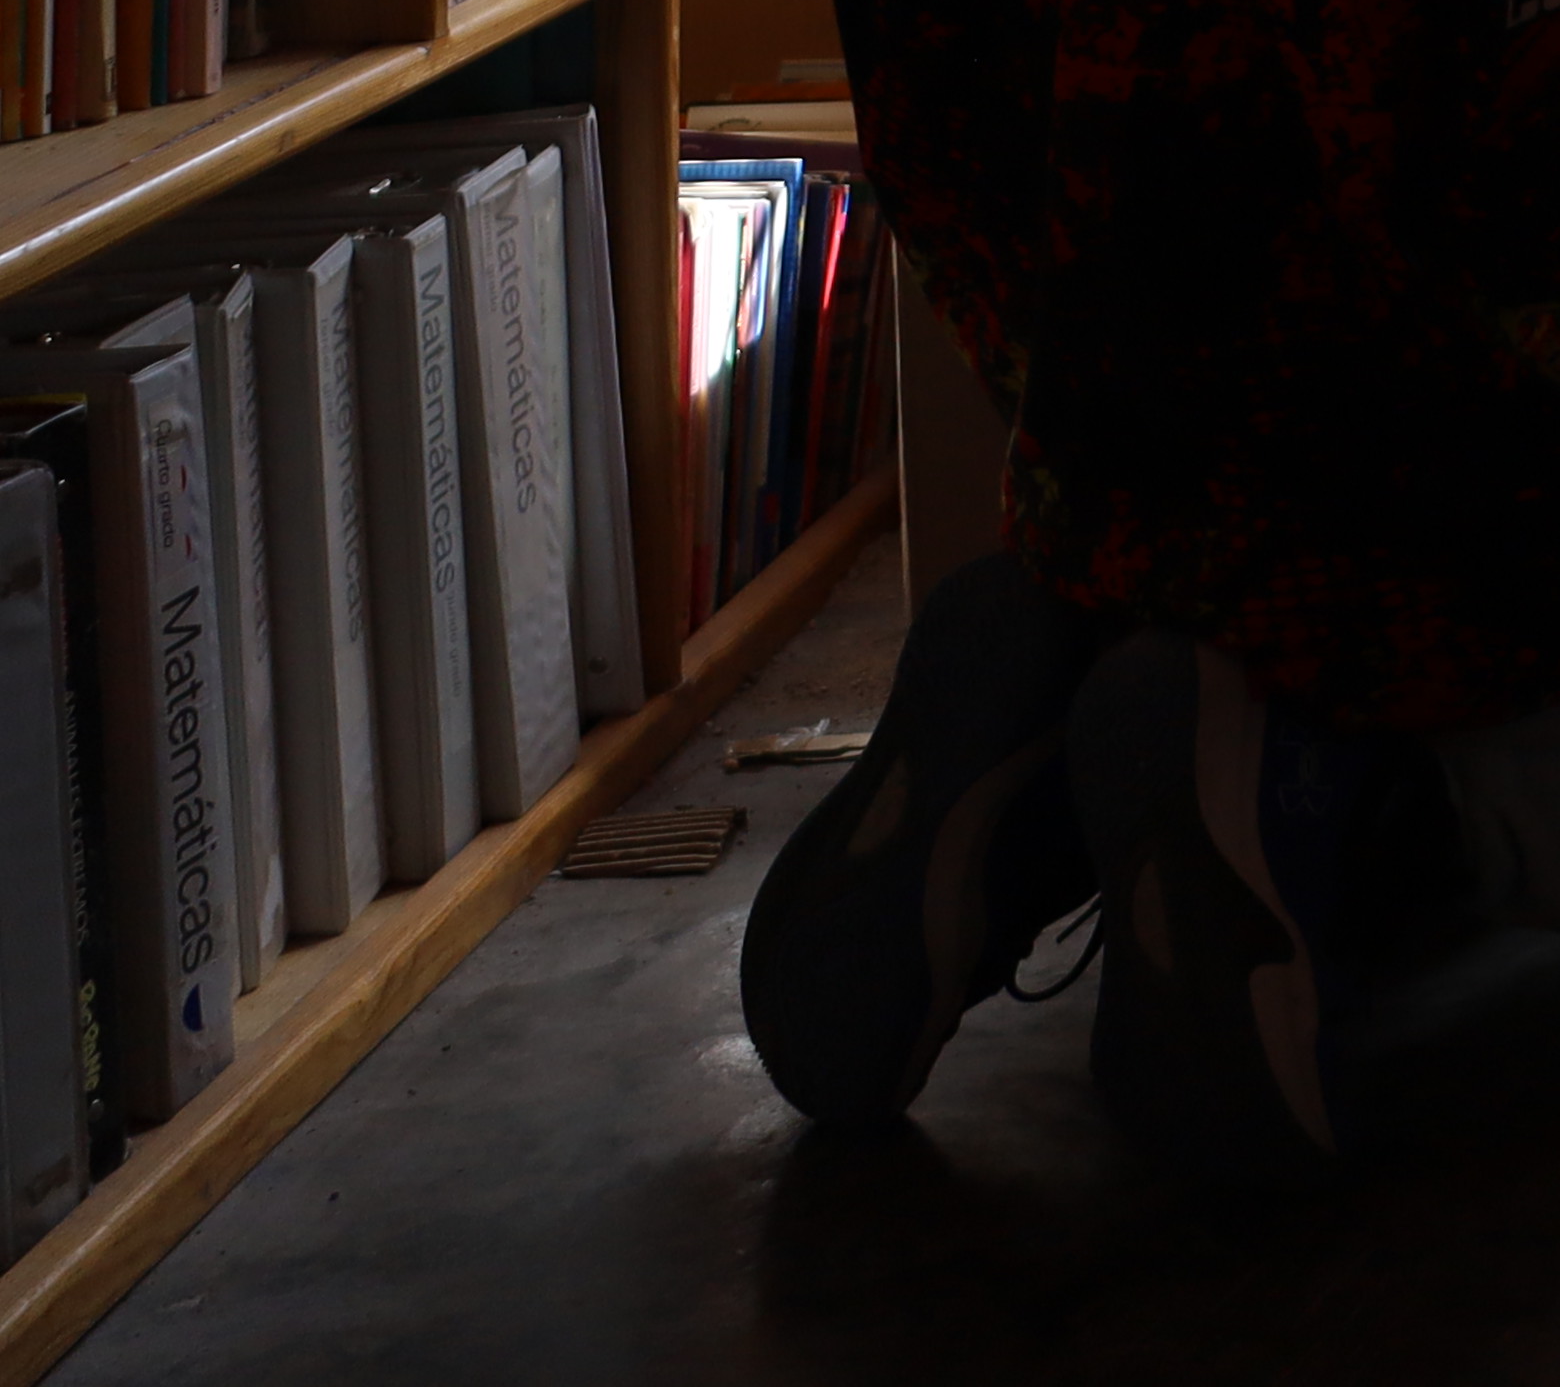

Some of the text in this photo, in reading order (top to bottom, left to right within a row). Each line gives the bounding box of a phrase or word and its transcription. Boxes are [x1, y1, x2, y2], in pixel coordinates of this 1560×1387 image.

[154, 419, 174, 547] Cuarto grado
[420, 264, 455, 593] Matemáticas
[493, 201, 536, 513] Matemáticas
[161, 585, 215, 975] Matemáticas
